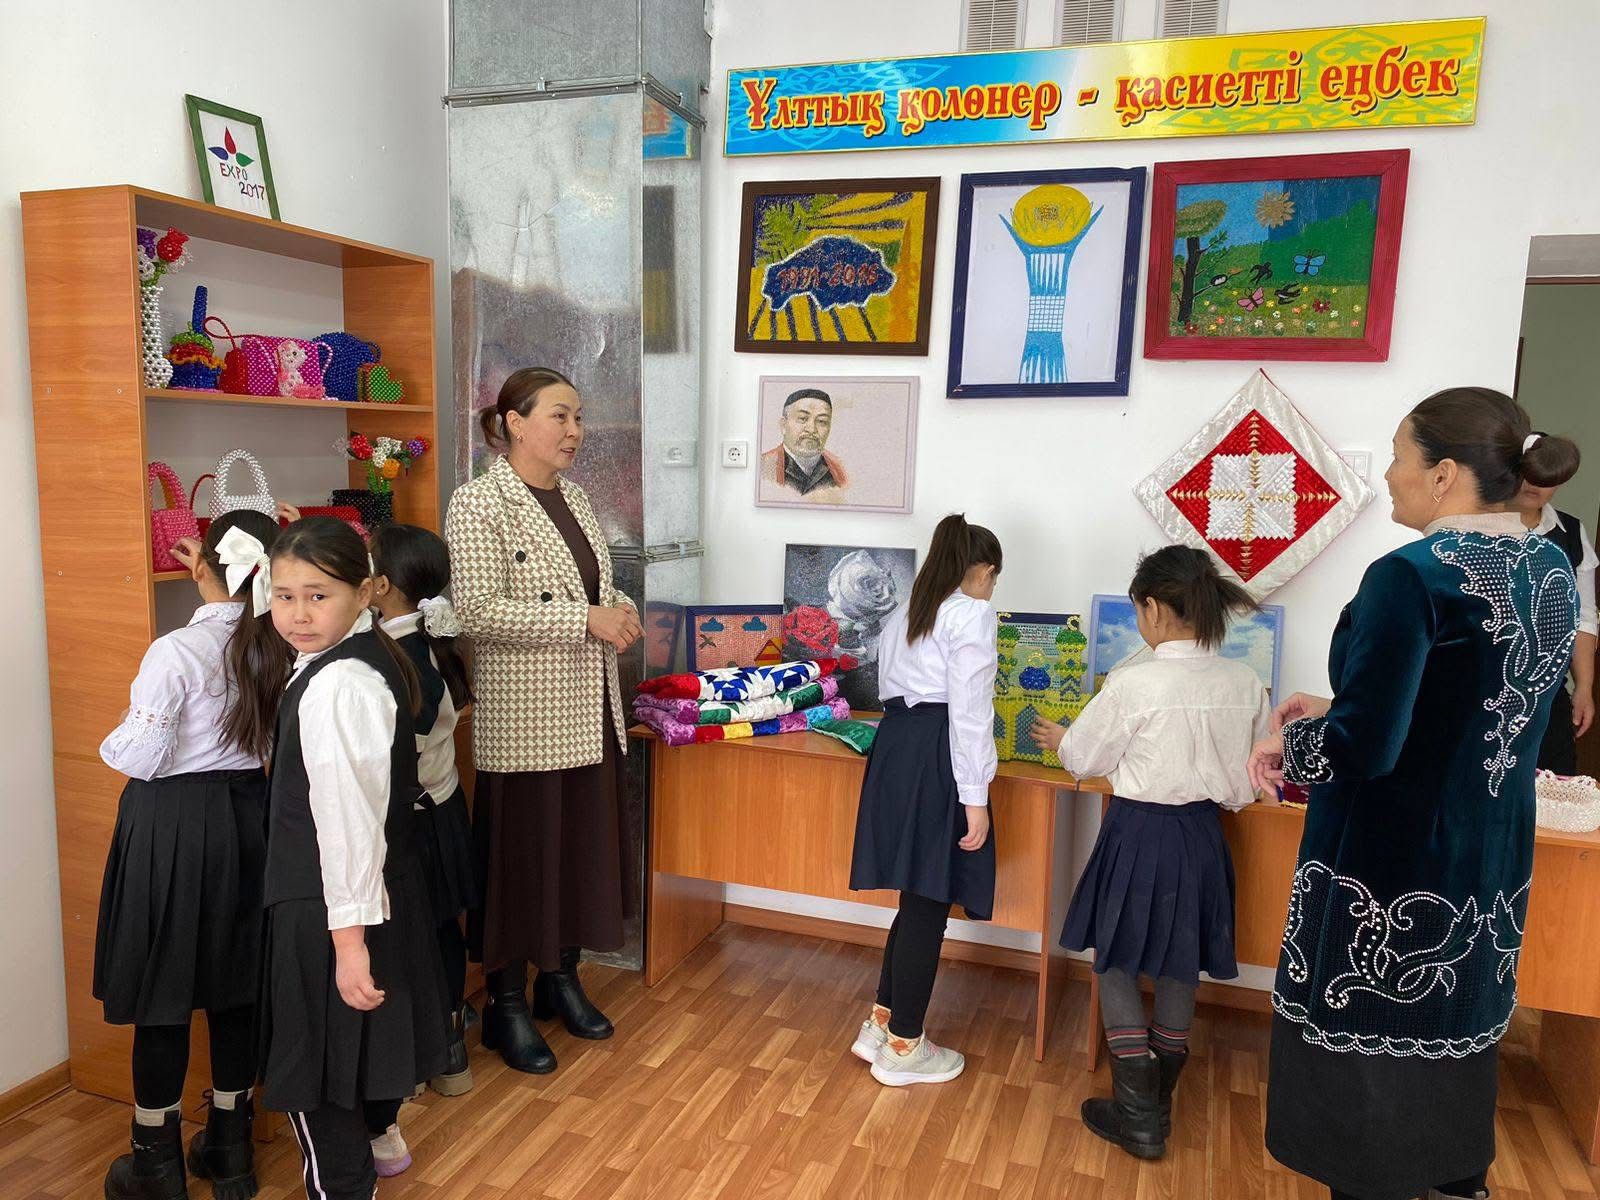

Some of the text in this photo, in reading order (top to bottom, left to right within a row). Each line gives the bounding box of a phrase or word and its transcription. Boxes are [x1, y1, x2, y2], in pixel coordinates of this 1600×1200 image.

[742, 78, 885, 137] Ұлттық
[898, 80, 1061, 135] қолөнер
[1079, 87, 1098, 106] -
[1115, 50, 1302, 126] қасиетті
[1320, 45, 1460, 116] еңбек
[219, 162, 248, 180] EXPO
[238, 181, 265, 200] 2017
